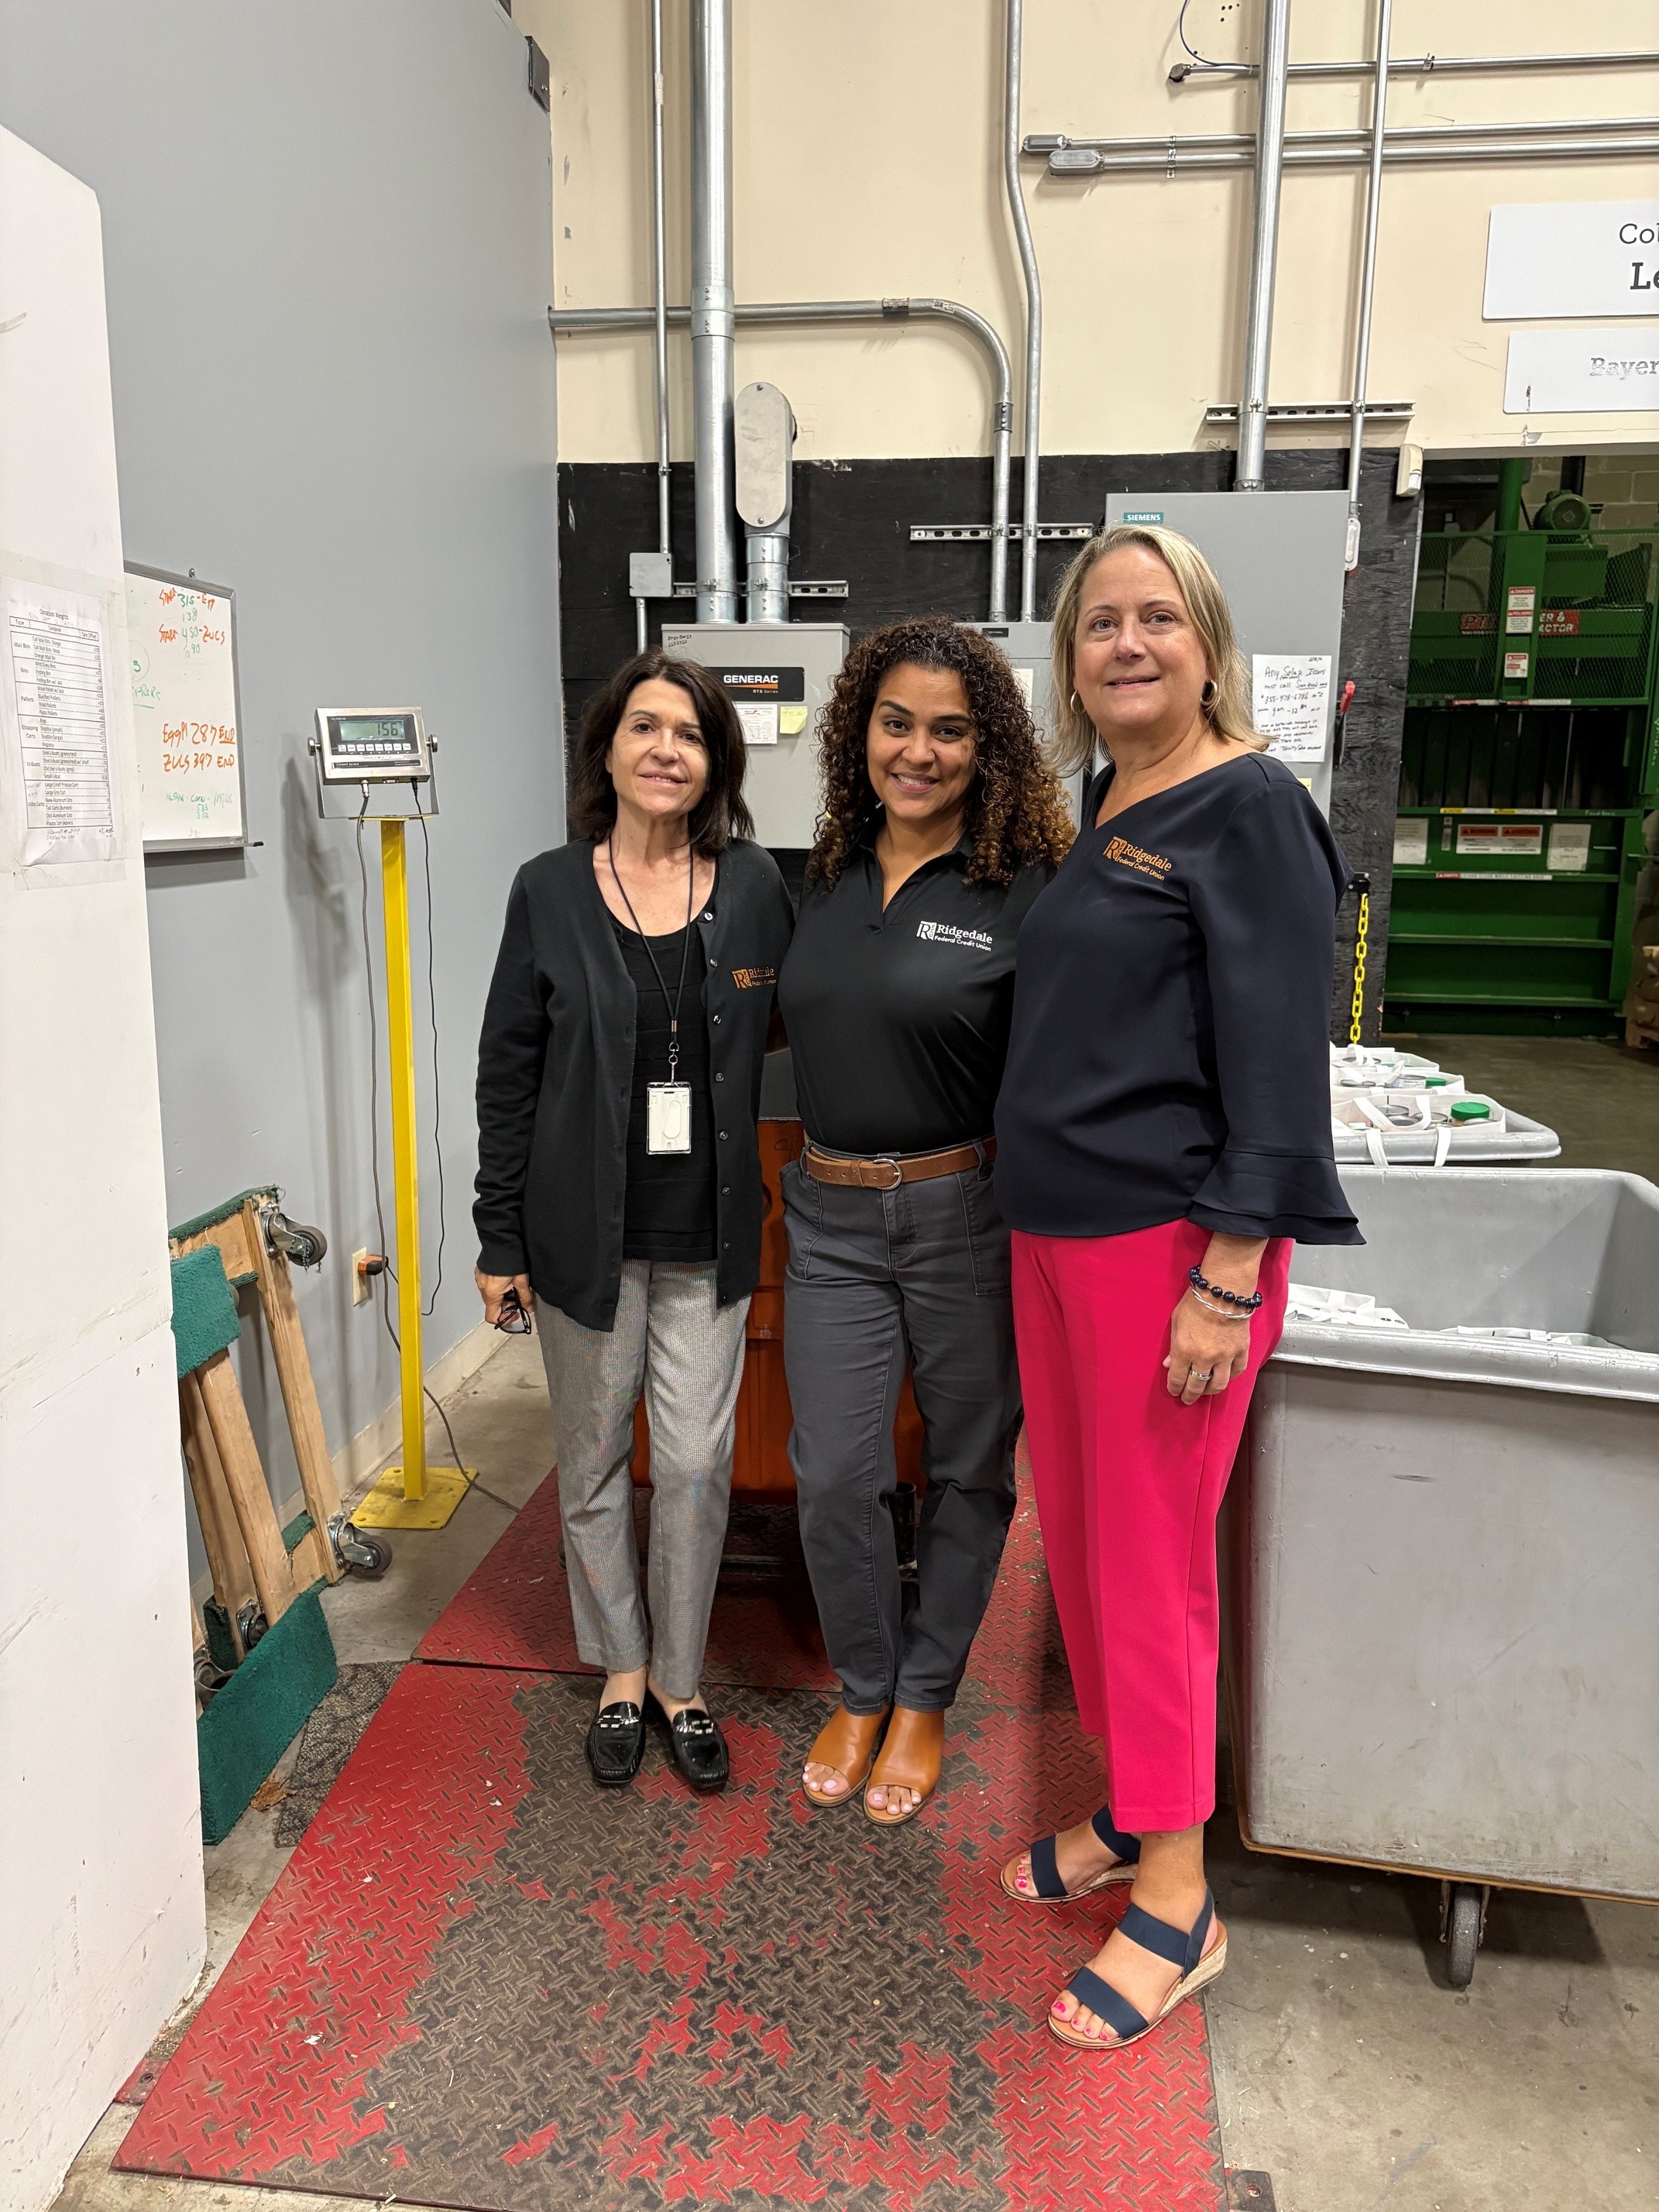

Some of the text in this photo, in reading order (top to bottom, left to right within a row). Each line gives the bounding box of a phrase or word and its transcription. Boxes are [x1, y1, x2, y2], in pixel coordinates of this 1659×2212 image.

[1620, 222, 1659, 244] Co
[177, 593, 194, 607] 315
[1265, 667, 1279, 680] Any
[191, 723, 217, 747] 287
[219, 725, 235, 742] END
[378, 723, 398, 736] 156
[194, 753, 212, 771] 397
[217, 754, 235, 768] END
[1122, 843, 1172, 871] Ridgedale
[1118, 856, 1165, 881] Federal Credit Union
[936, 924, 992, 943] Ridgedale
[976, 943, 991, 952] Union
